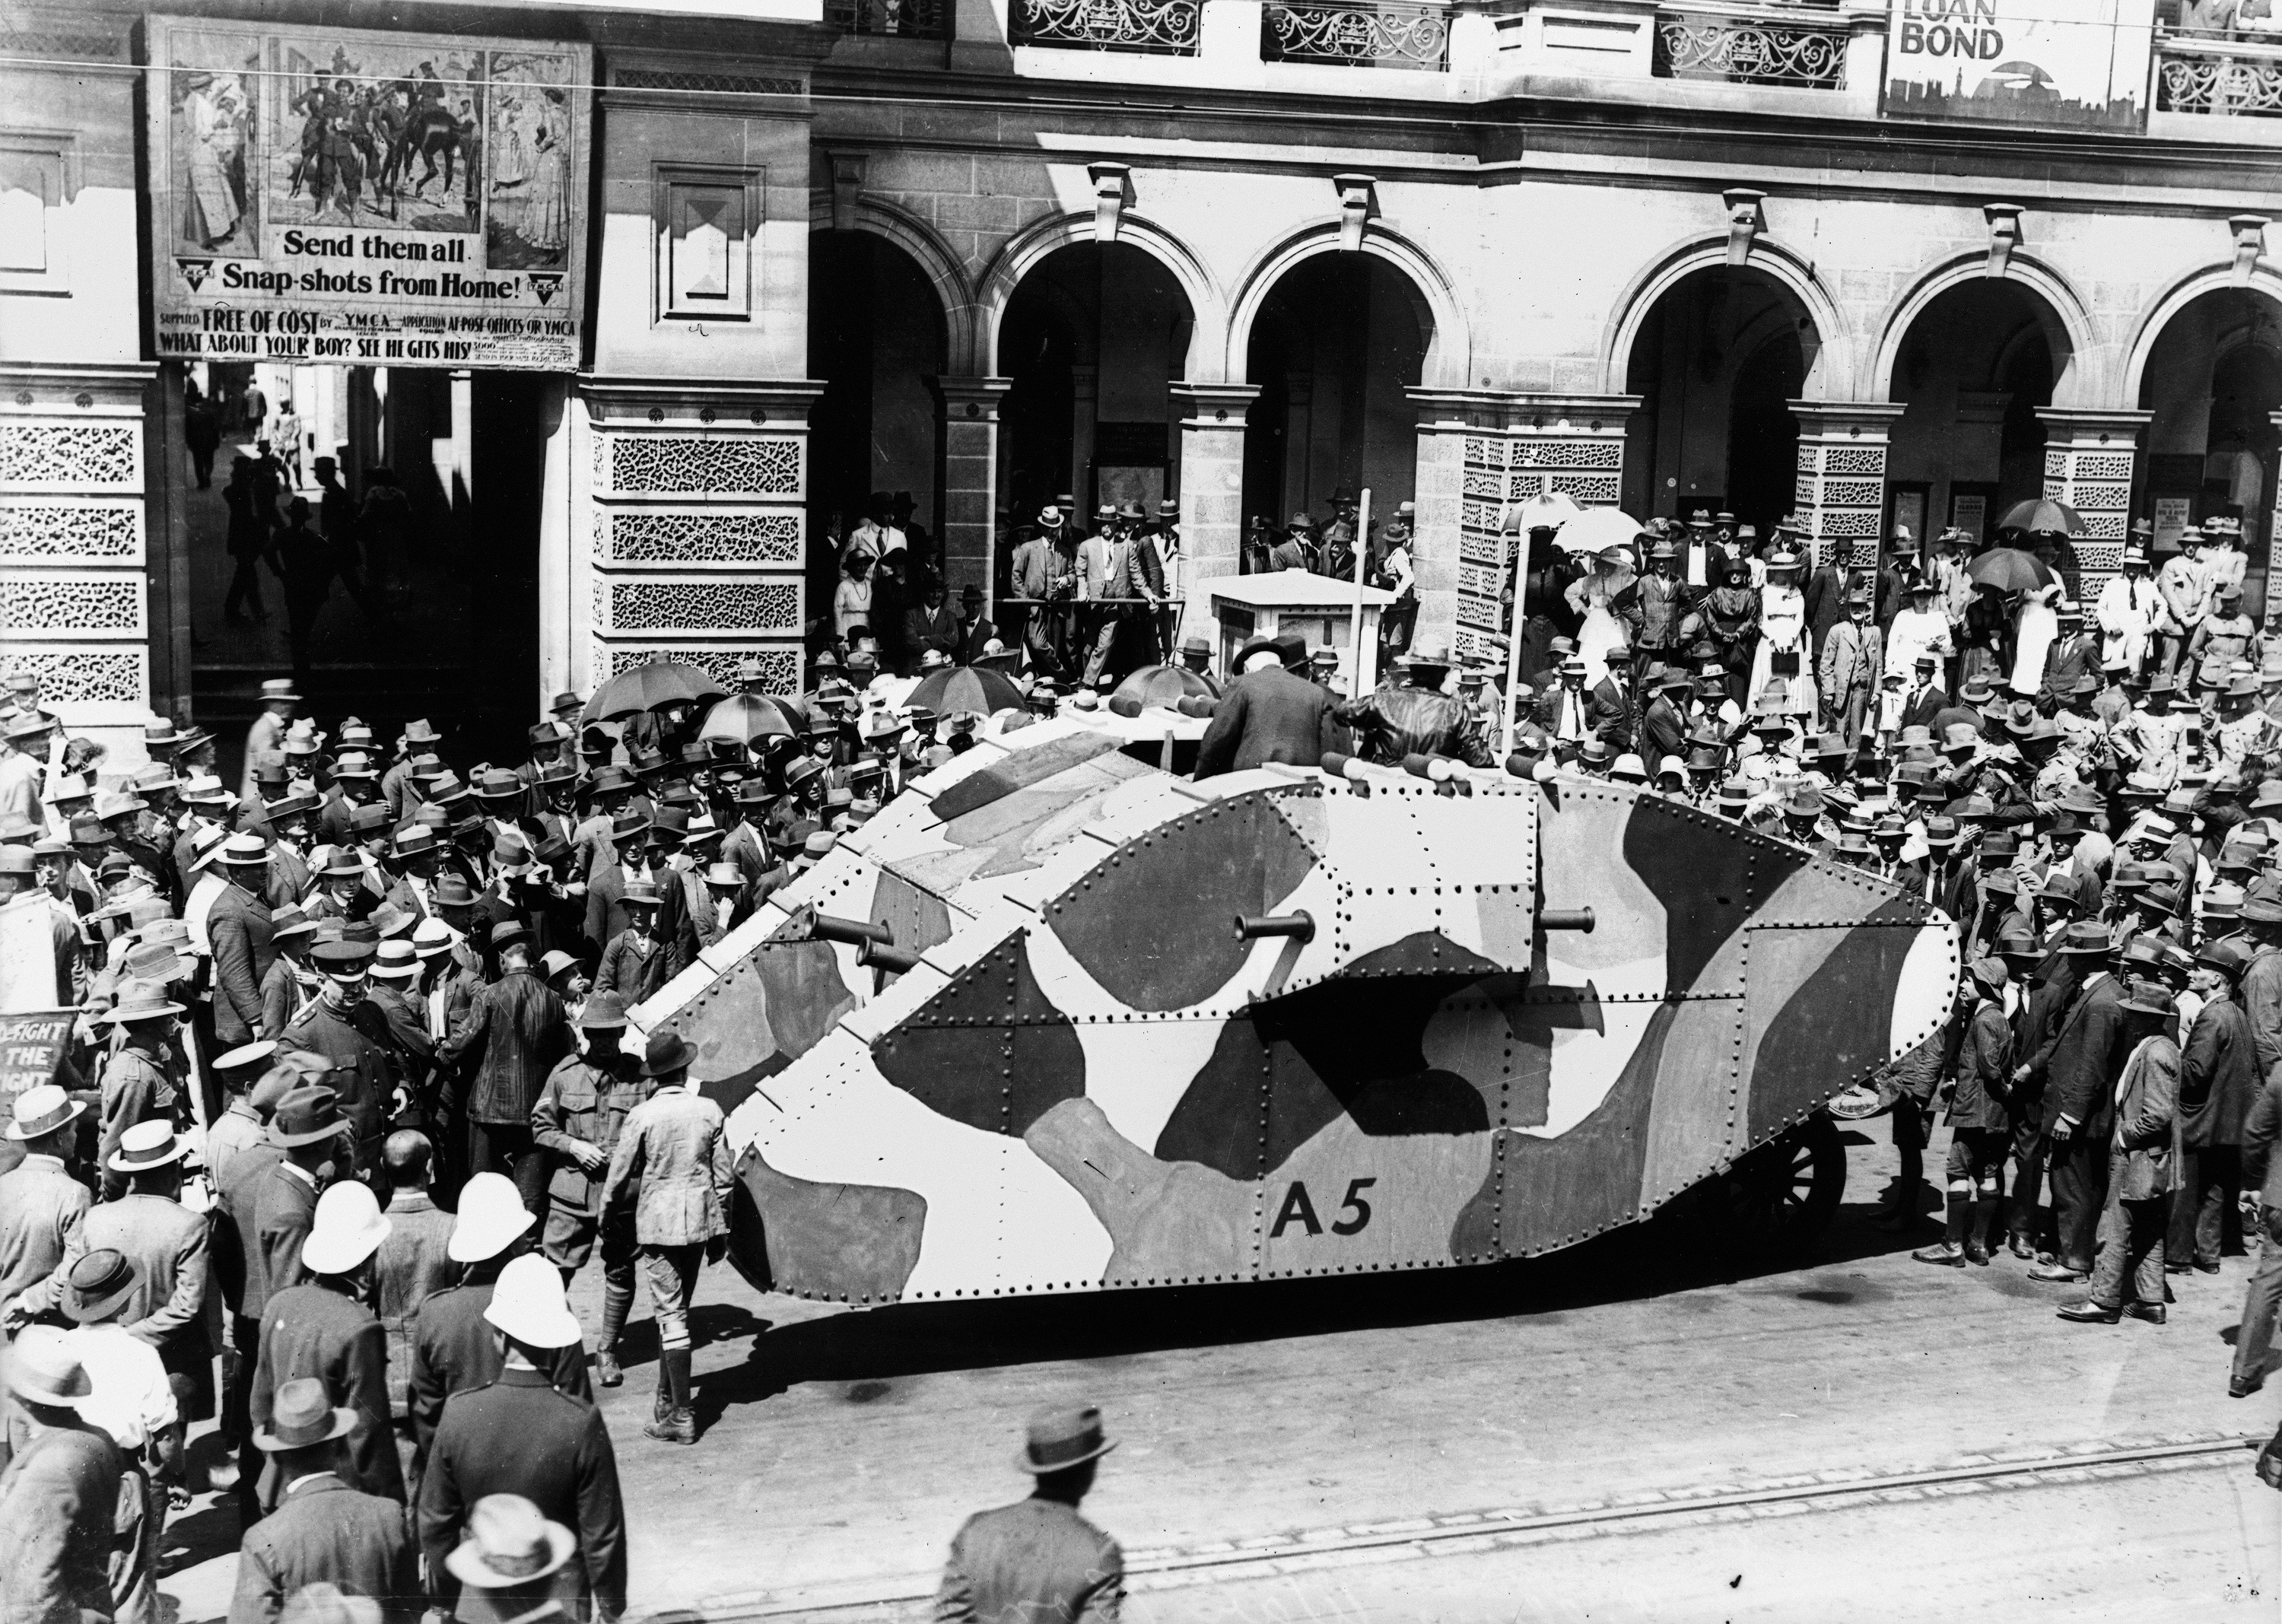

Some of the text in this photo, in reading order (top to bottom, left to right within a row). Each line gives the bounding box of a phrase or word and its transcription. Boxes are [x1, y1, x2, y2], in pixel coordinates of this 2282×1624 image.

[1904, 0, 1996, 25] LOAN
[1900, 22, 2004, 59] BOND
[284, 230, 464, 263] Send them all
[222, 262, 520, 300] Snap-shots from Home!
[160, 313, 200, 325] SUPPLIED
[202, 309, 245, 332] FREE
[250, 310, 274, 334] OF
[277, 310, 320, 335] COST
[319, 316, 333, 328] BY
[402, 315, 447, 328] APPLICATION
[448, 316, 459, 332] AT
[461, 316, 485, 332] POST
[487, 317, 524, 335] OFFICES
[526, 319, 542, 335] OR
[544, 319, 575, 336] YMCA
[160, 332, 472, 360] WHAT ABOUT YOUR BOY? SEE HE GETS HIS!
[6, 1046, 52, 1066] THE
[0, 1071, 53, 1092] IGHT
[1270, 1177, 1378, 1238] A5
